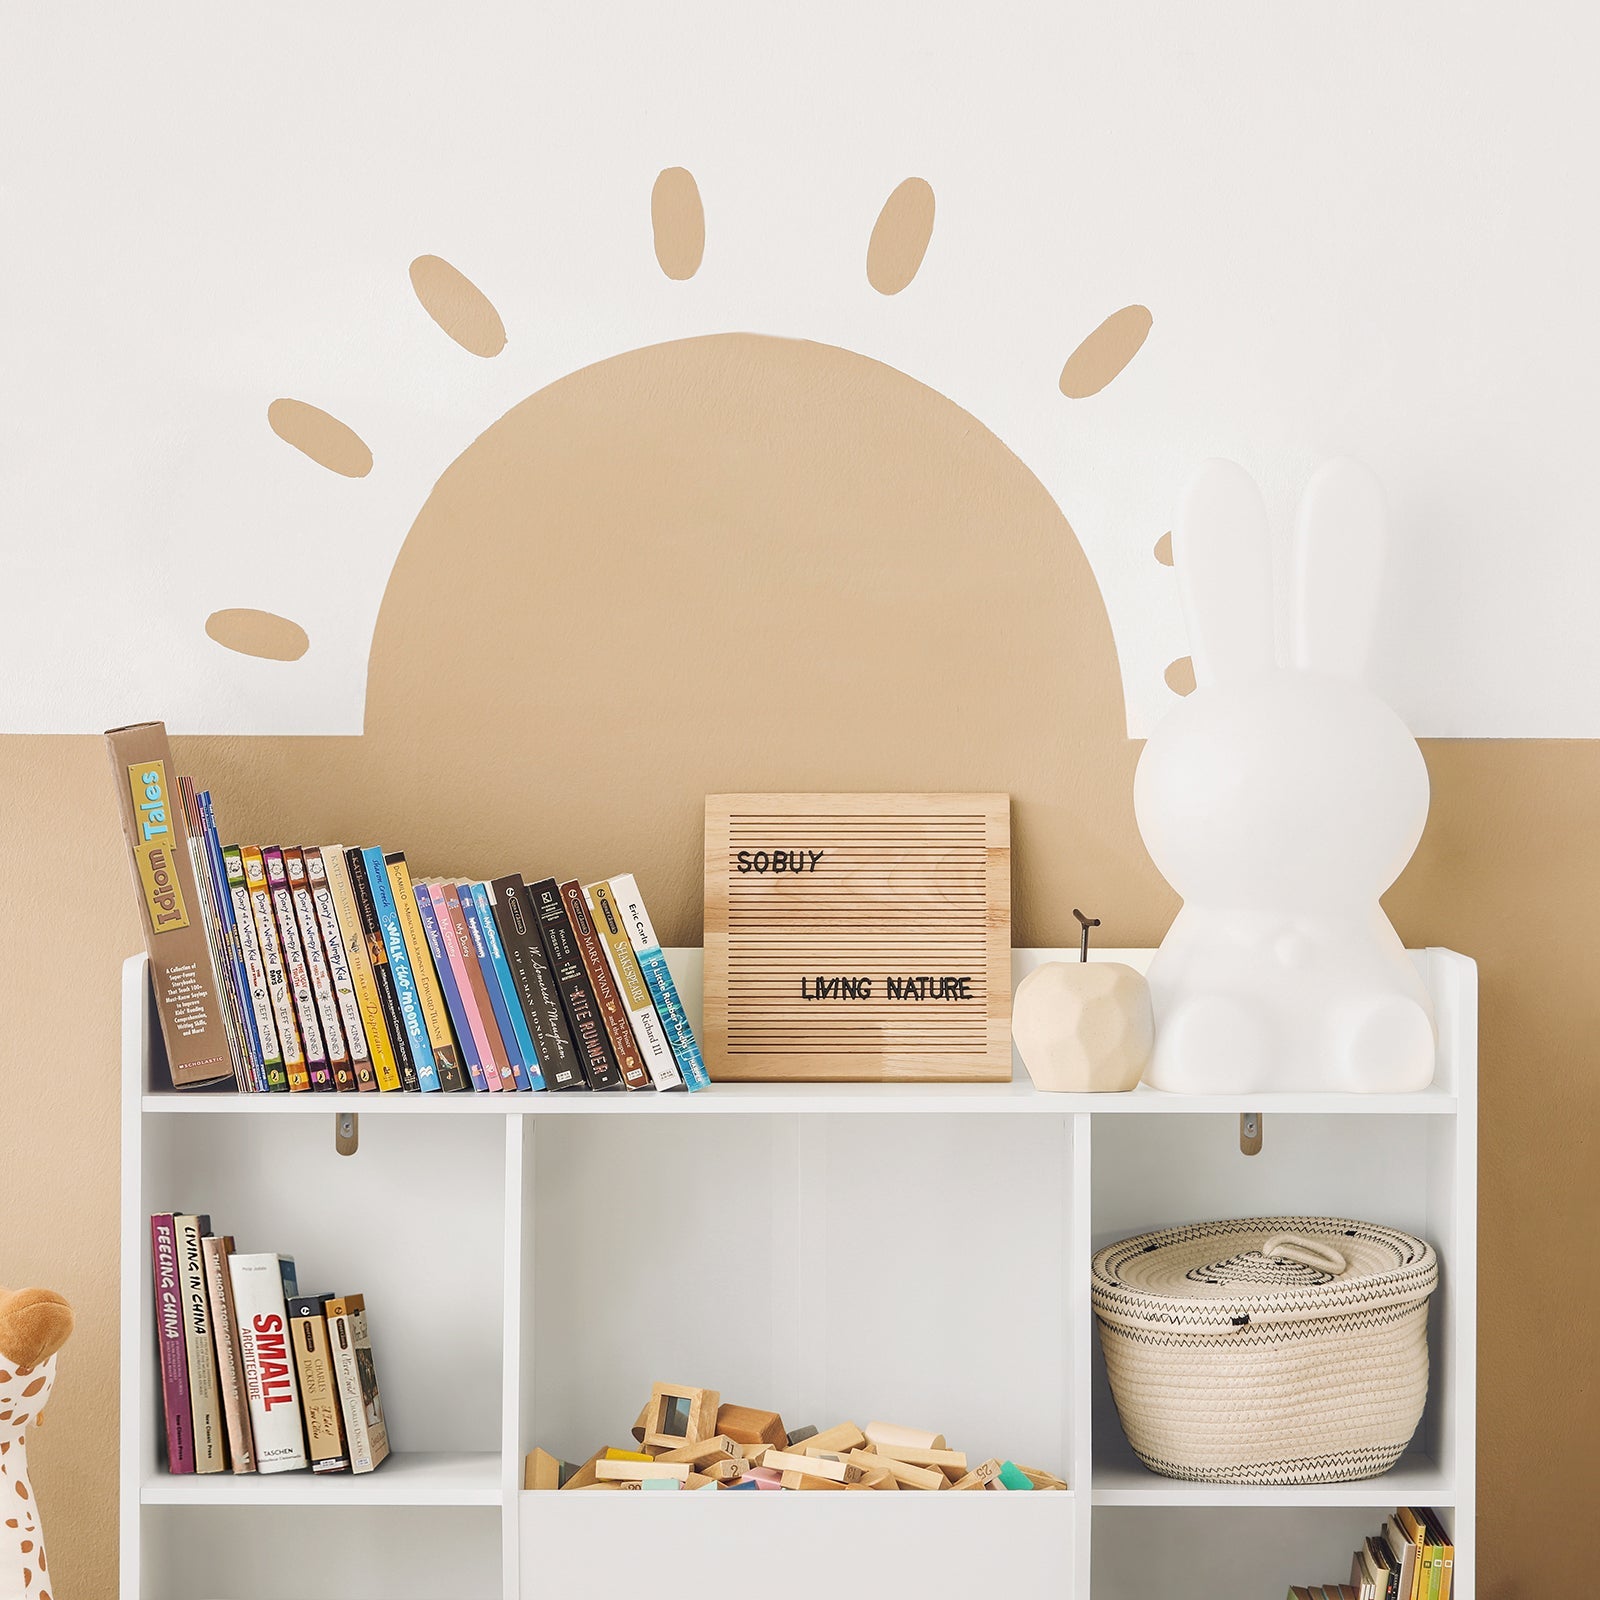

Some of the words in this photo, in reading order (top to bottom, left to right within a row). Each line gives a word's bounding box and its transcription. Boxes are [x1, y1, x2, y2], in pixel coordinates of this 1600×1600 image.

[140, 771, 168, 840] Tales
[331, 855, 342, 878] KATE
[352, 857, 364, 880] KATE
[736, 850, 824, 874] SOBUY
[149, 849, 181, 924] Idiom
[372, 860, 382, 883] Sharon
[379, 885, 391, 908] Creech
[317, 892, 332, 919] Diary
[235, 889, 247, 911] Diary
[243, 925, 253, 951] Wimpy
[248, 949, 256, 961] Kid
[256, 893, 267, 915] Diary
[264, 928, 274, 952] Wimpy
[269, 953, 277, 964] Kid
[278, 892, 289, 913] Diary
[286, 926, 296, 950] Wimpy
[291, 950, 300, 962] Kid
[298, 892, 309, 913] Diary
[307, 926, 316, 950] Wimpy
[312, 950, 320, 962] Kid
[328, 921, 334, 929] of
[426, 917, 434, 929] My
[440, 919, 447, 929] My
[456, 923, 462, 935] My
[460, 935, 469, 957] Daddy
[628, 903, 640, 921] Eric
[636, 921, 648, 945] Carle
[328, 936, 340, 965] Wimpy
[387, 922, 405, 962] WALK
[549, 928, 562, 960] HOSSEINI
[559, 929, 570, 954] KHALED
[336, 966, 347, 980] Kid
[395, 964, 409, 990] two
[584, 936, 600, 965] MARK
[594, 965, 611, 999] TWAIN
[614, 940, 645, 1003] SHAKESPEARE
[570, 989, 592, 1022] KITE
[650, 958, 658, 967] 10
[654, 967, 665, 991] Little
[662, 992, 678, 1022] Rubber
[674, 1022, 688, 1049] Ducks
[801, 976, 872, 1001] LIVING
[887, 976, 975, 1001] NATURE
[259, 1004, 268, 1020] JEFF
[280, 1007, 289, 1025] JEFF
[402, 992, 421, 1037] moons
[422, 977, 435, 1011] EDWARD
[430, 1010, 442, 1040] TULANE
[514, 951, 522, 963] OF
[519, 969, 534, 1006] HUMAN
[531, 1011, 550, 1061] BONDAGE
[531, 959, 556, 1006] Somerset
[545, 1007, 568, 1059] Maughan
[263, 1025, 274, 1055] KINNEY
[284, 1028, 296, 1058] KINNEY
[303, 1005, 312, 1022] JEFF
[308, 1026, 319, 1056] KINNEY
[324, 1005, 333, 1022] JEFF
[329, 1026, 340, 1056] KINNEY
[346, 1003, 355, 1020] JEFF
[351, 1025, 362, 1054] KINNEY
[367, 1001, 381, 1054] Despereaux
[622, 1030, 632, 1048] Prince
[641, 1012, 659, 1043] Richard
[652, 1043, 663, 1056] III
[184, 1056, 224, 1068] SCHOLASTIC
[579, 1021, 608, 1075] RUNNER
[616, 1035, 626, 1056] Pauper
[157, 1226, 174, 1288] FEELING
[184, 1227, 199, 1271] LIVING
[190, 1276, 201, 1290] IN
[216, 1273, 225, 1302] SHORT
[163, 1292, 179, 1339] CHINA
[192, 1294, 206, 1334] CHINA
[220, 1302, 230, 1332] STORY
[242, 1328, 260, 1400] ARCHITECTURE
[253, 1314, 293, 1412] SMALL
[304, 1360, 316, 1394] DICKENS
[315, 1358, 326, 1393] CHARLES
[264, 1448, 293, 1456] TASCHEN
[725, 1441, 734, 1452] 11
[731, 1464, 739, 1477] 2
[976, 1463, 993, 1480] 25
